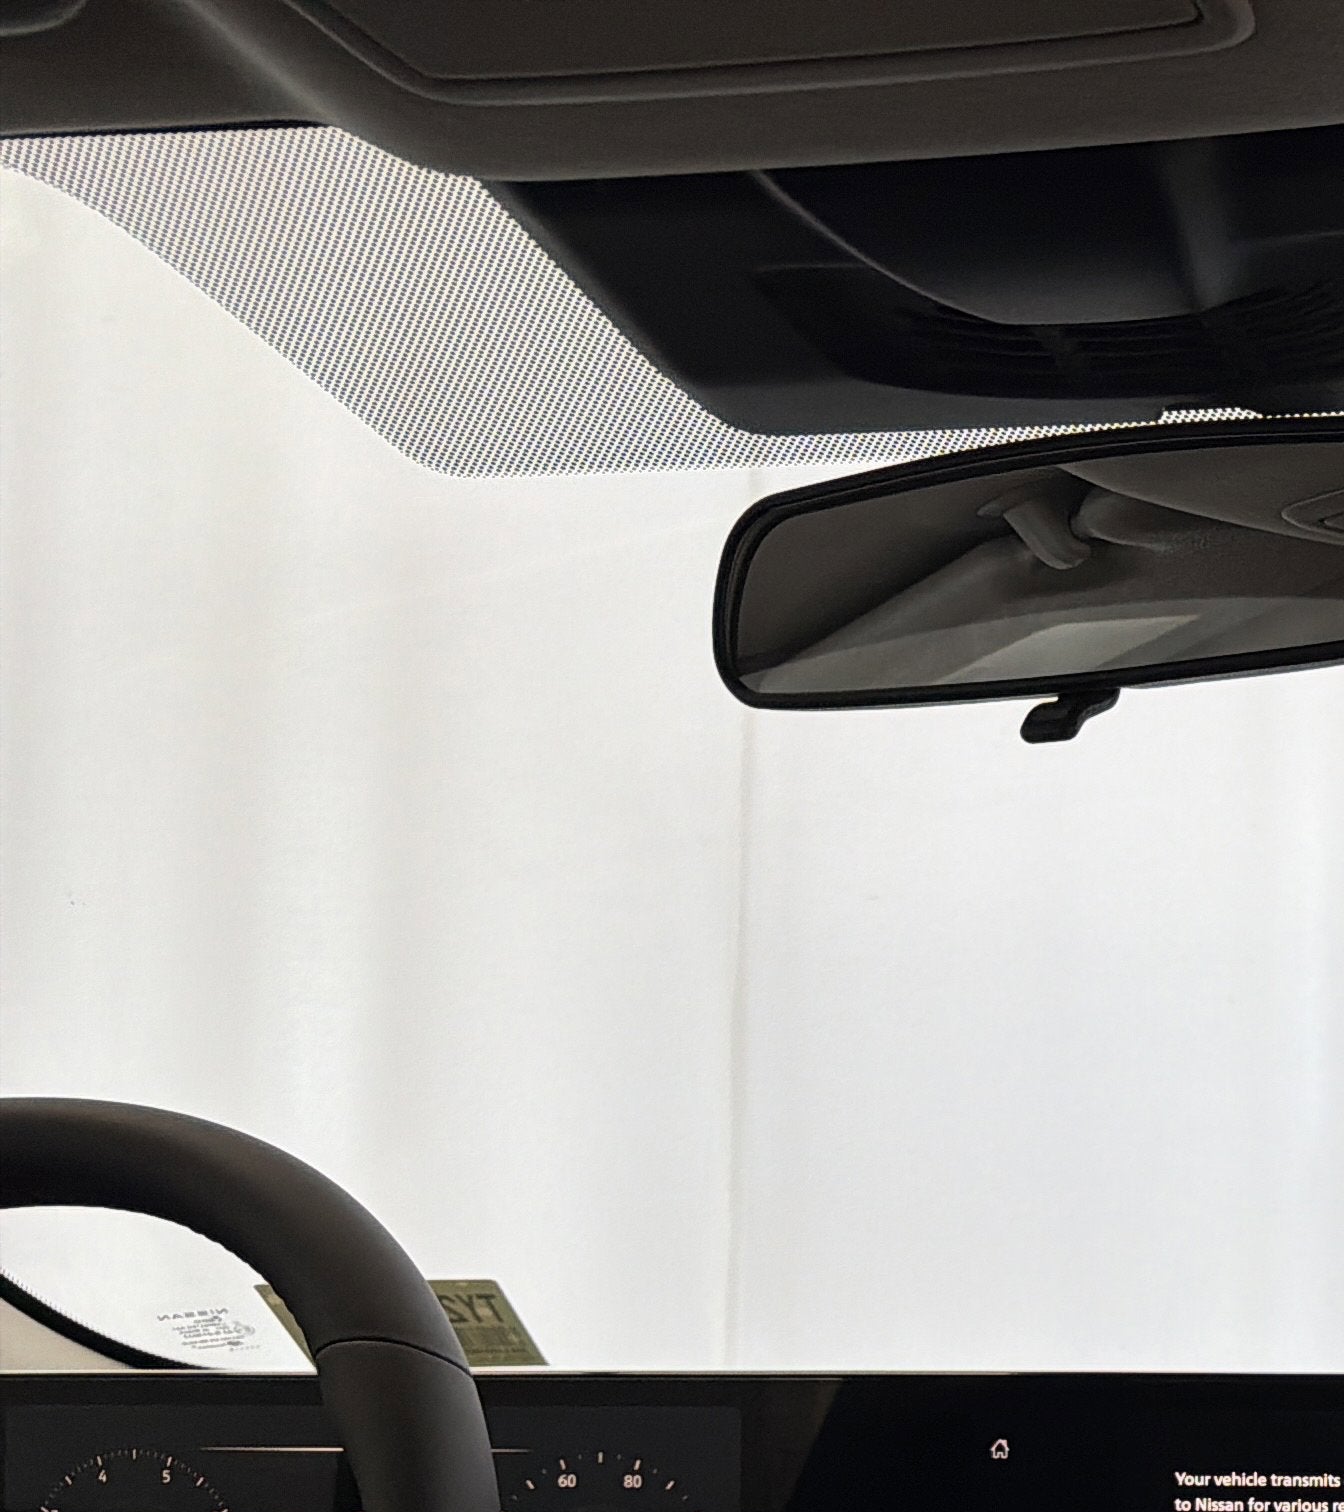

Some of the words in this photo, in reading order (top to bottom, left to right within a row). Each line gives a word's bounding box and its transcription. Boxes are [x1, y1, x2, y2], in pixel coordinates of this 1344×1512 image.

[97, 1470, 108, 1483] 4
[161, 1470, 171, 1483] 5
[557, 1475, 577, 1488] 60
[623, 1475, 643, 1488] 80
[1173, 1470, 1212, 1488] Your
[1212, 1470, 1268, 1488] vehicle
[1268, 1472, 1342, 1489] transmits
[1173, 1497, 1192, 1512] to
[1194, 1496, 1245, 1512] Nissan
